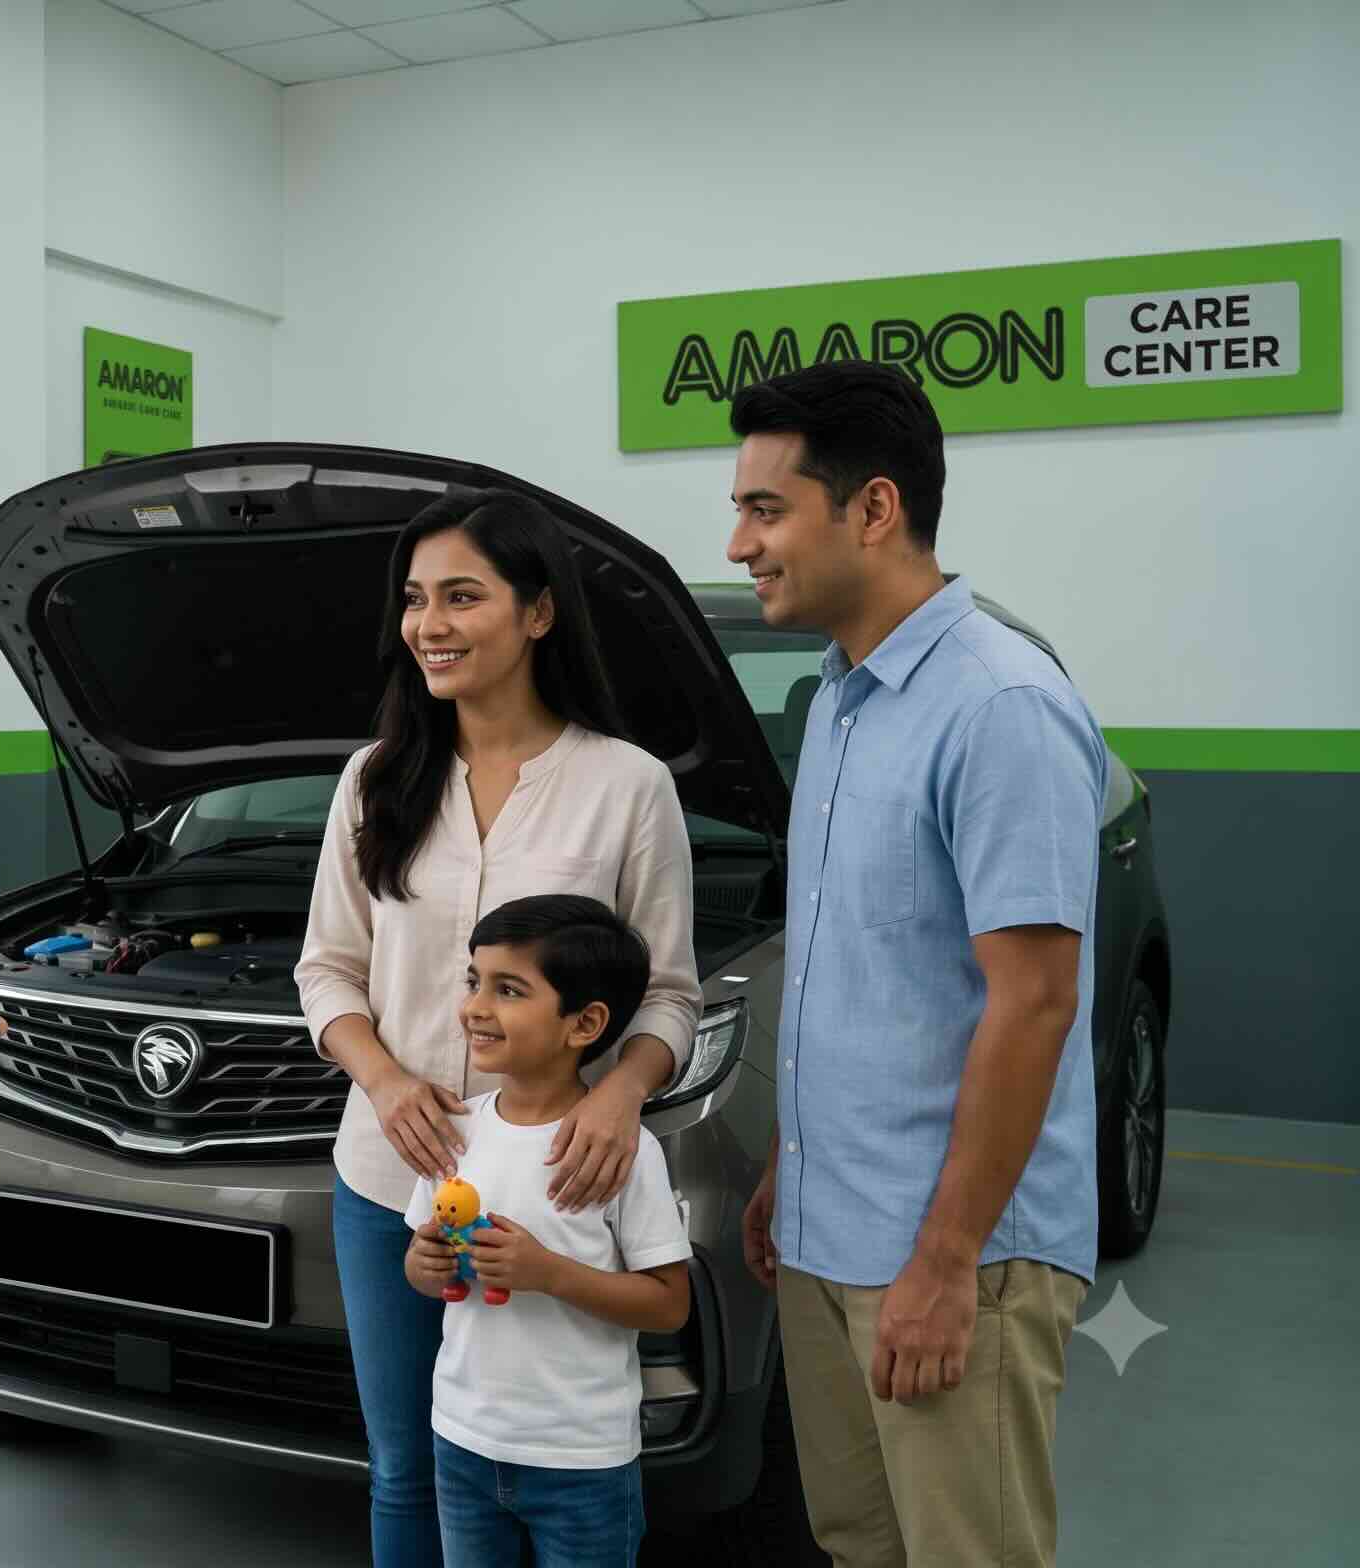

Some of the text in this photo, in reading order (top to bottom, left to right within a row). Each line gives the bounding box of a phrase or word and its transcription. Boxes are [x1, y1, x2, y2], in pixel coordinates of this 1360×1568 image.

[1130, 294, 1251, 334] CARE
[1104, 335, 1281, 378] CENTER
[97, 359, 184, 404] AMARON
